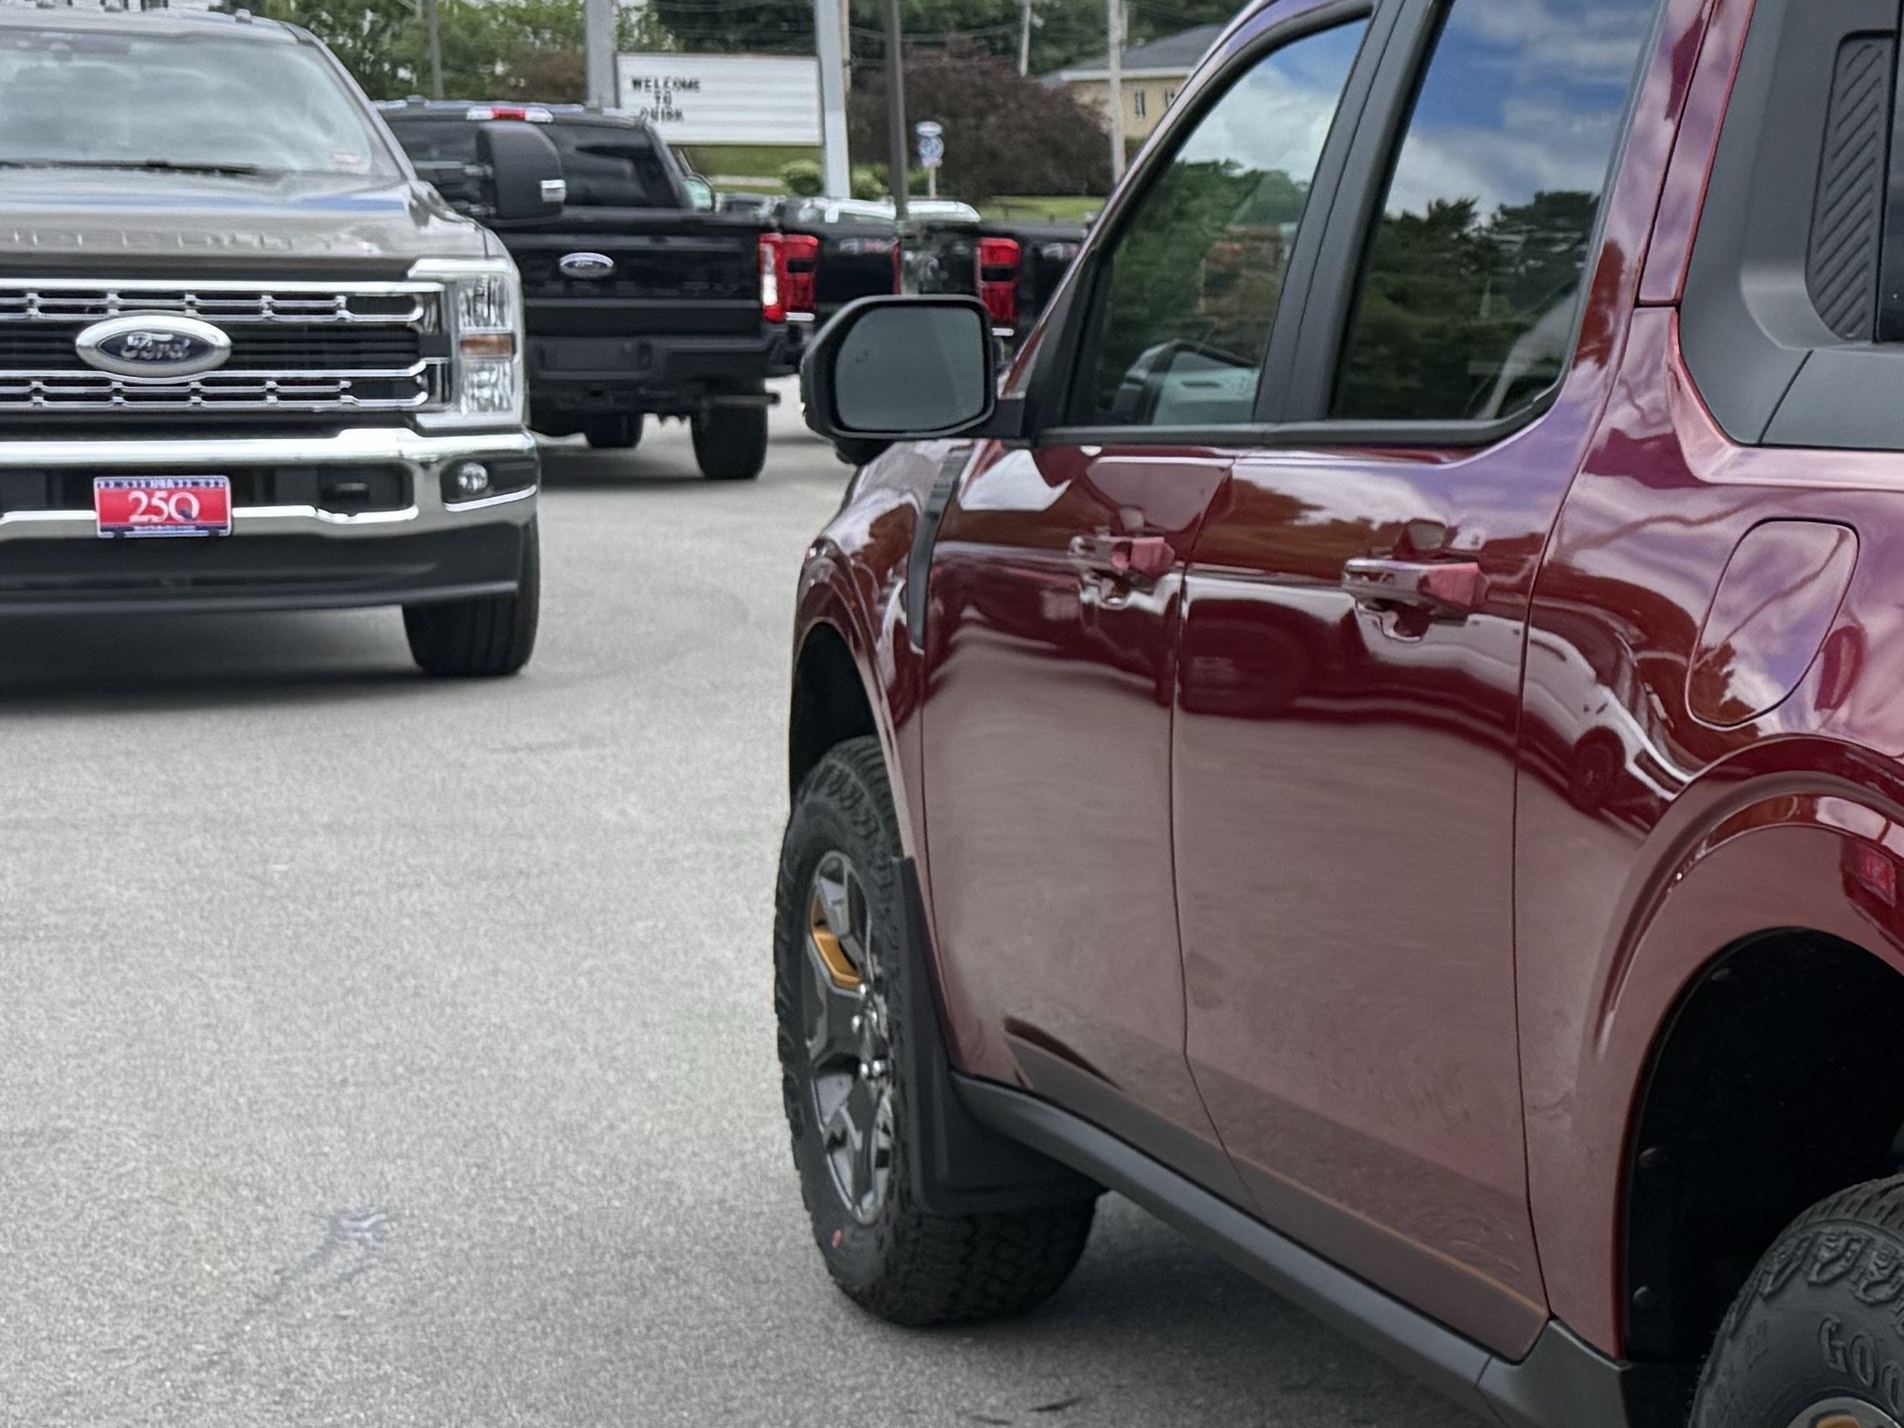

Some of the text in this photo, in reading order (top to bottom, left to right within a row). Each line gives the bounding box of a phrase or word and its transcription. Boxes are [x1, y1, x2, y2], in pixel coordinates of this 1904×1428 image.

[631, 76, 701, 93] WELCOME
[654, 91, 673, 107] TO
[120, 331, 191, 361] Ford
